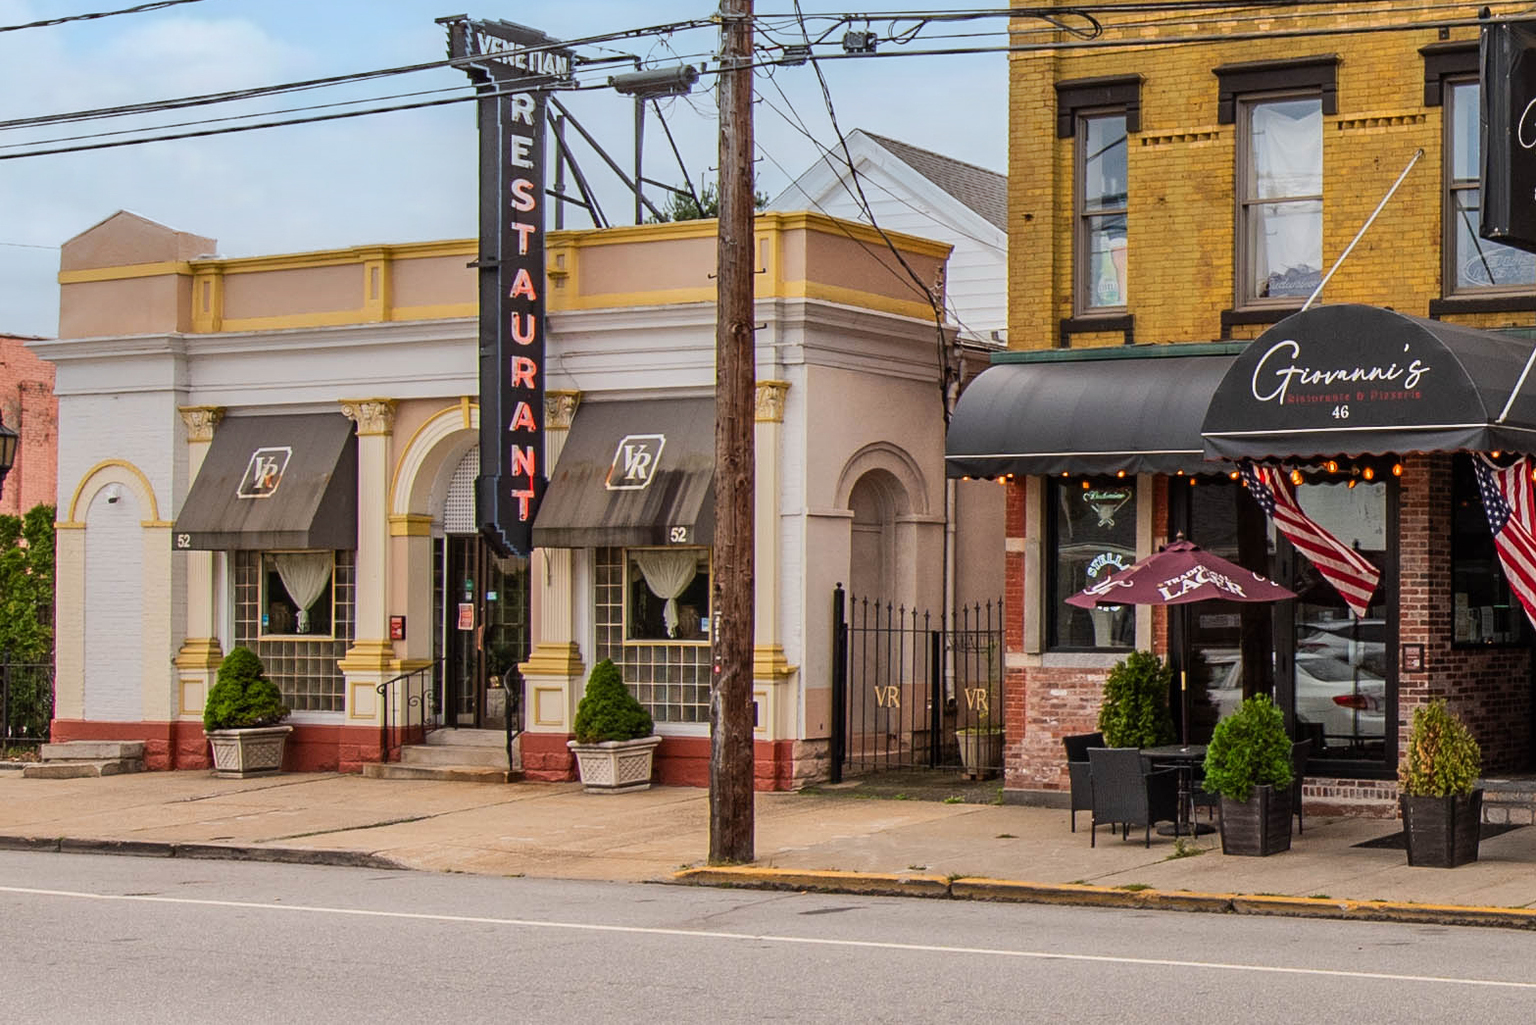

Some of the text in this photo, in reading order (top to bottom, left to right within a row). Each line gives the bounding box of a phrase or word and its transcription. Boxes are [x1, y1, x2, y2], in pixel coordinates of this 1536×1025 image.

[476, 30, 568, 81] VENETIAN
[509, 92, 538, 522] RESTAURANT
[1252, 339, 1430, 405] Giovanni's
[1332, 405, 1350, 419] 46
[253, 456, 278, 489] VR
[623, 444, 651, 480] VR
[177, 534, 191, 548] 52
[671, 527, 686, 542] 52
[1087, 553, 1130, 578] STELL
[874, 685, 900, 708] VR
[964, 687, 989, 711] VR
